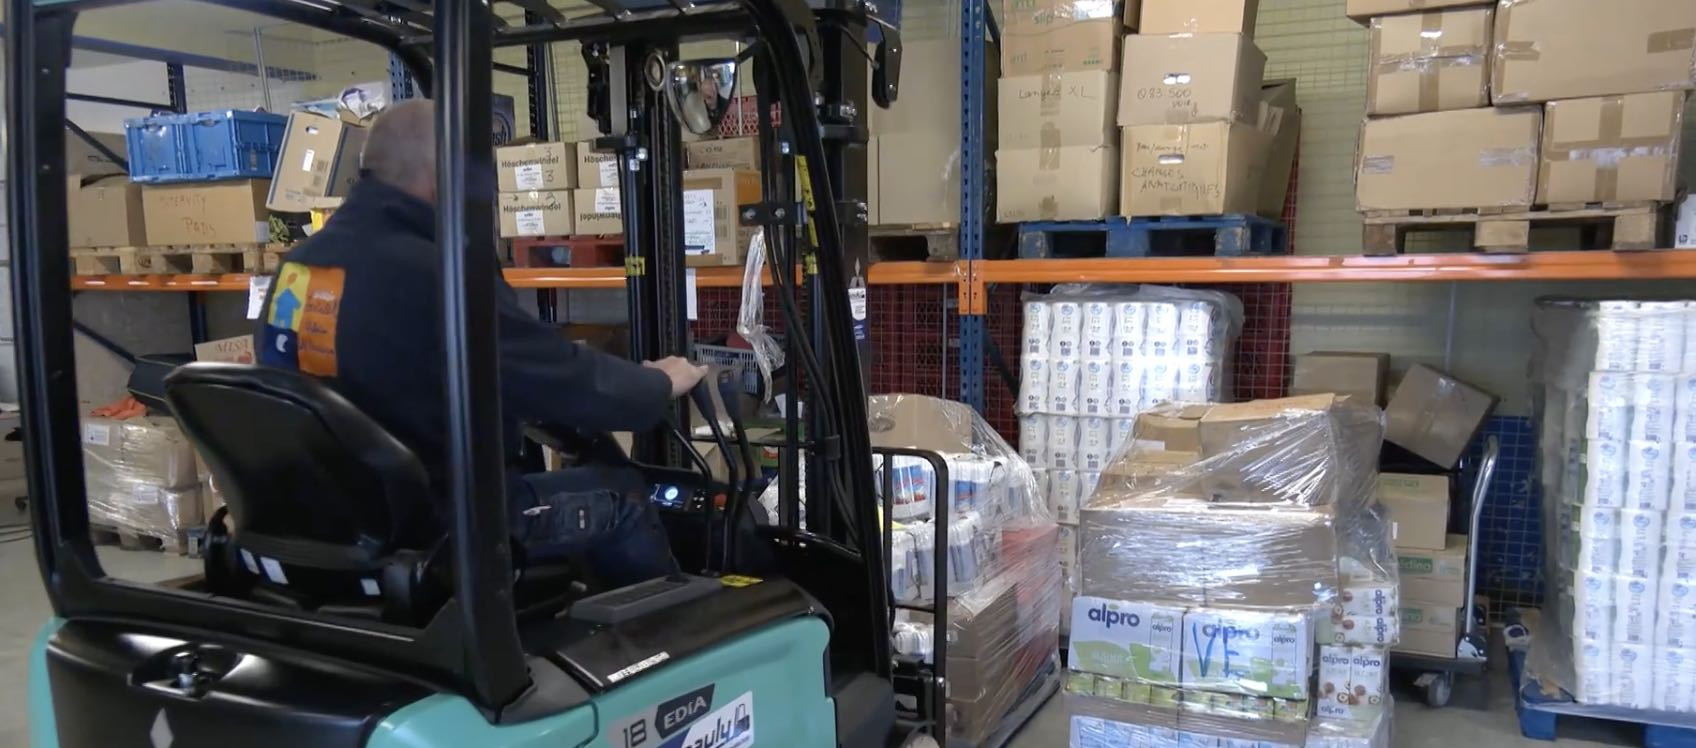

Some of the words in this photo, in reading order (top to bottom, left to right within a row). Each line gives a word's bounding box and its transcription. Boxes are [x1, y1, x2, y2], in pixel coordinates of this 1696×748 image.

[1373, 589, 1386, 615] alpro
[1088, 603, 1140, 628] alpro
[1152, 622, 1172, 634] alpro
[1374, 616, 1387, 643] alpro
[1273, 635, 1296, 645] alpro
[1322, 653, 1349, 666] alpro
[1353, 654, 1381, 668] alpro
